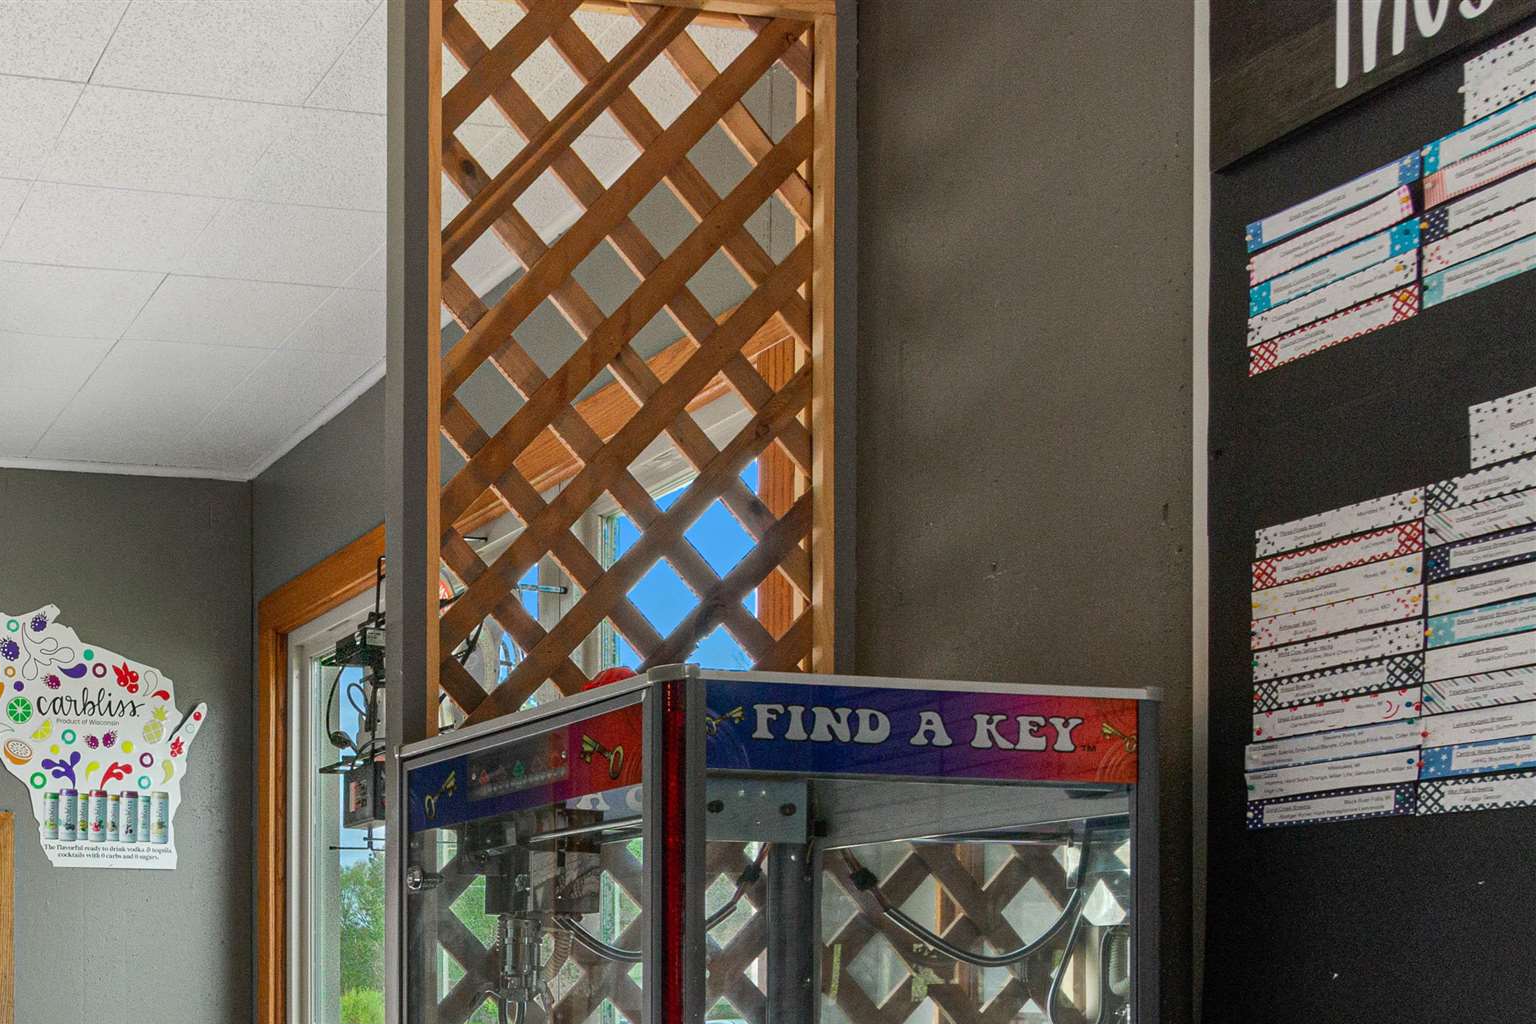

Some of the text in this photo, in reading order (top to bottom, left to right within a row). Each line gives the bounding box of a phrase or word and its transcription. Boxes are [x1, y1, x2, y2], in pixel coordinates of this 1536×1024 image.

[751, 702, 892, 745] FIND
[910, 711, 953, 748] A
[969, 713, 1084, 753] KEY
